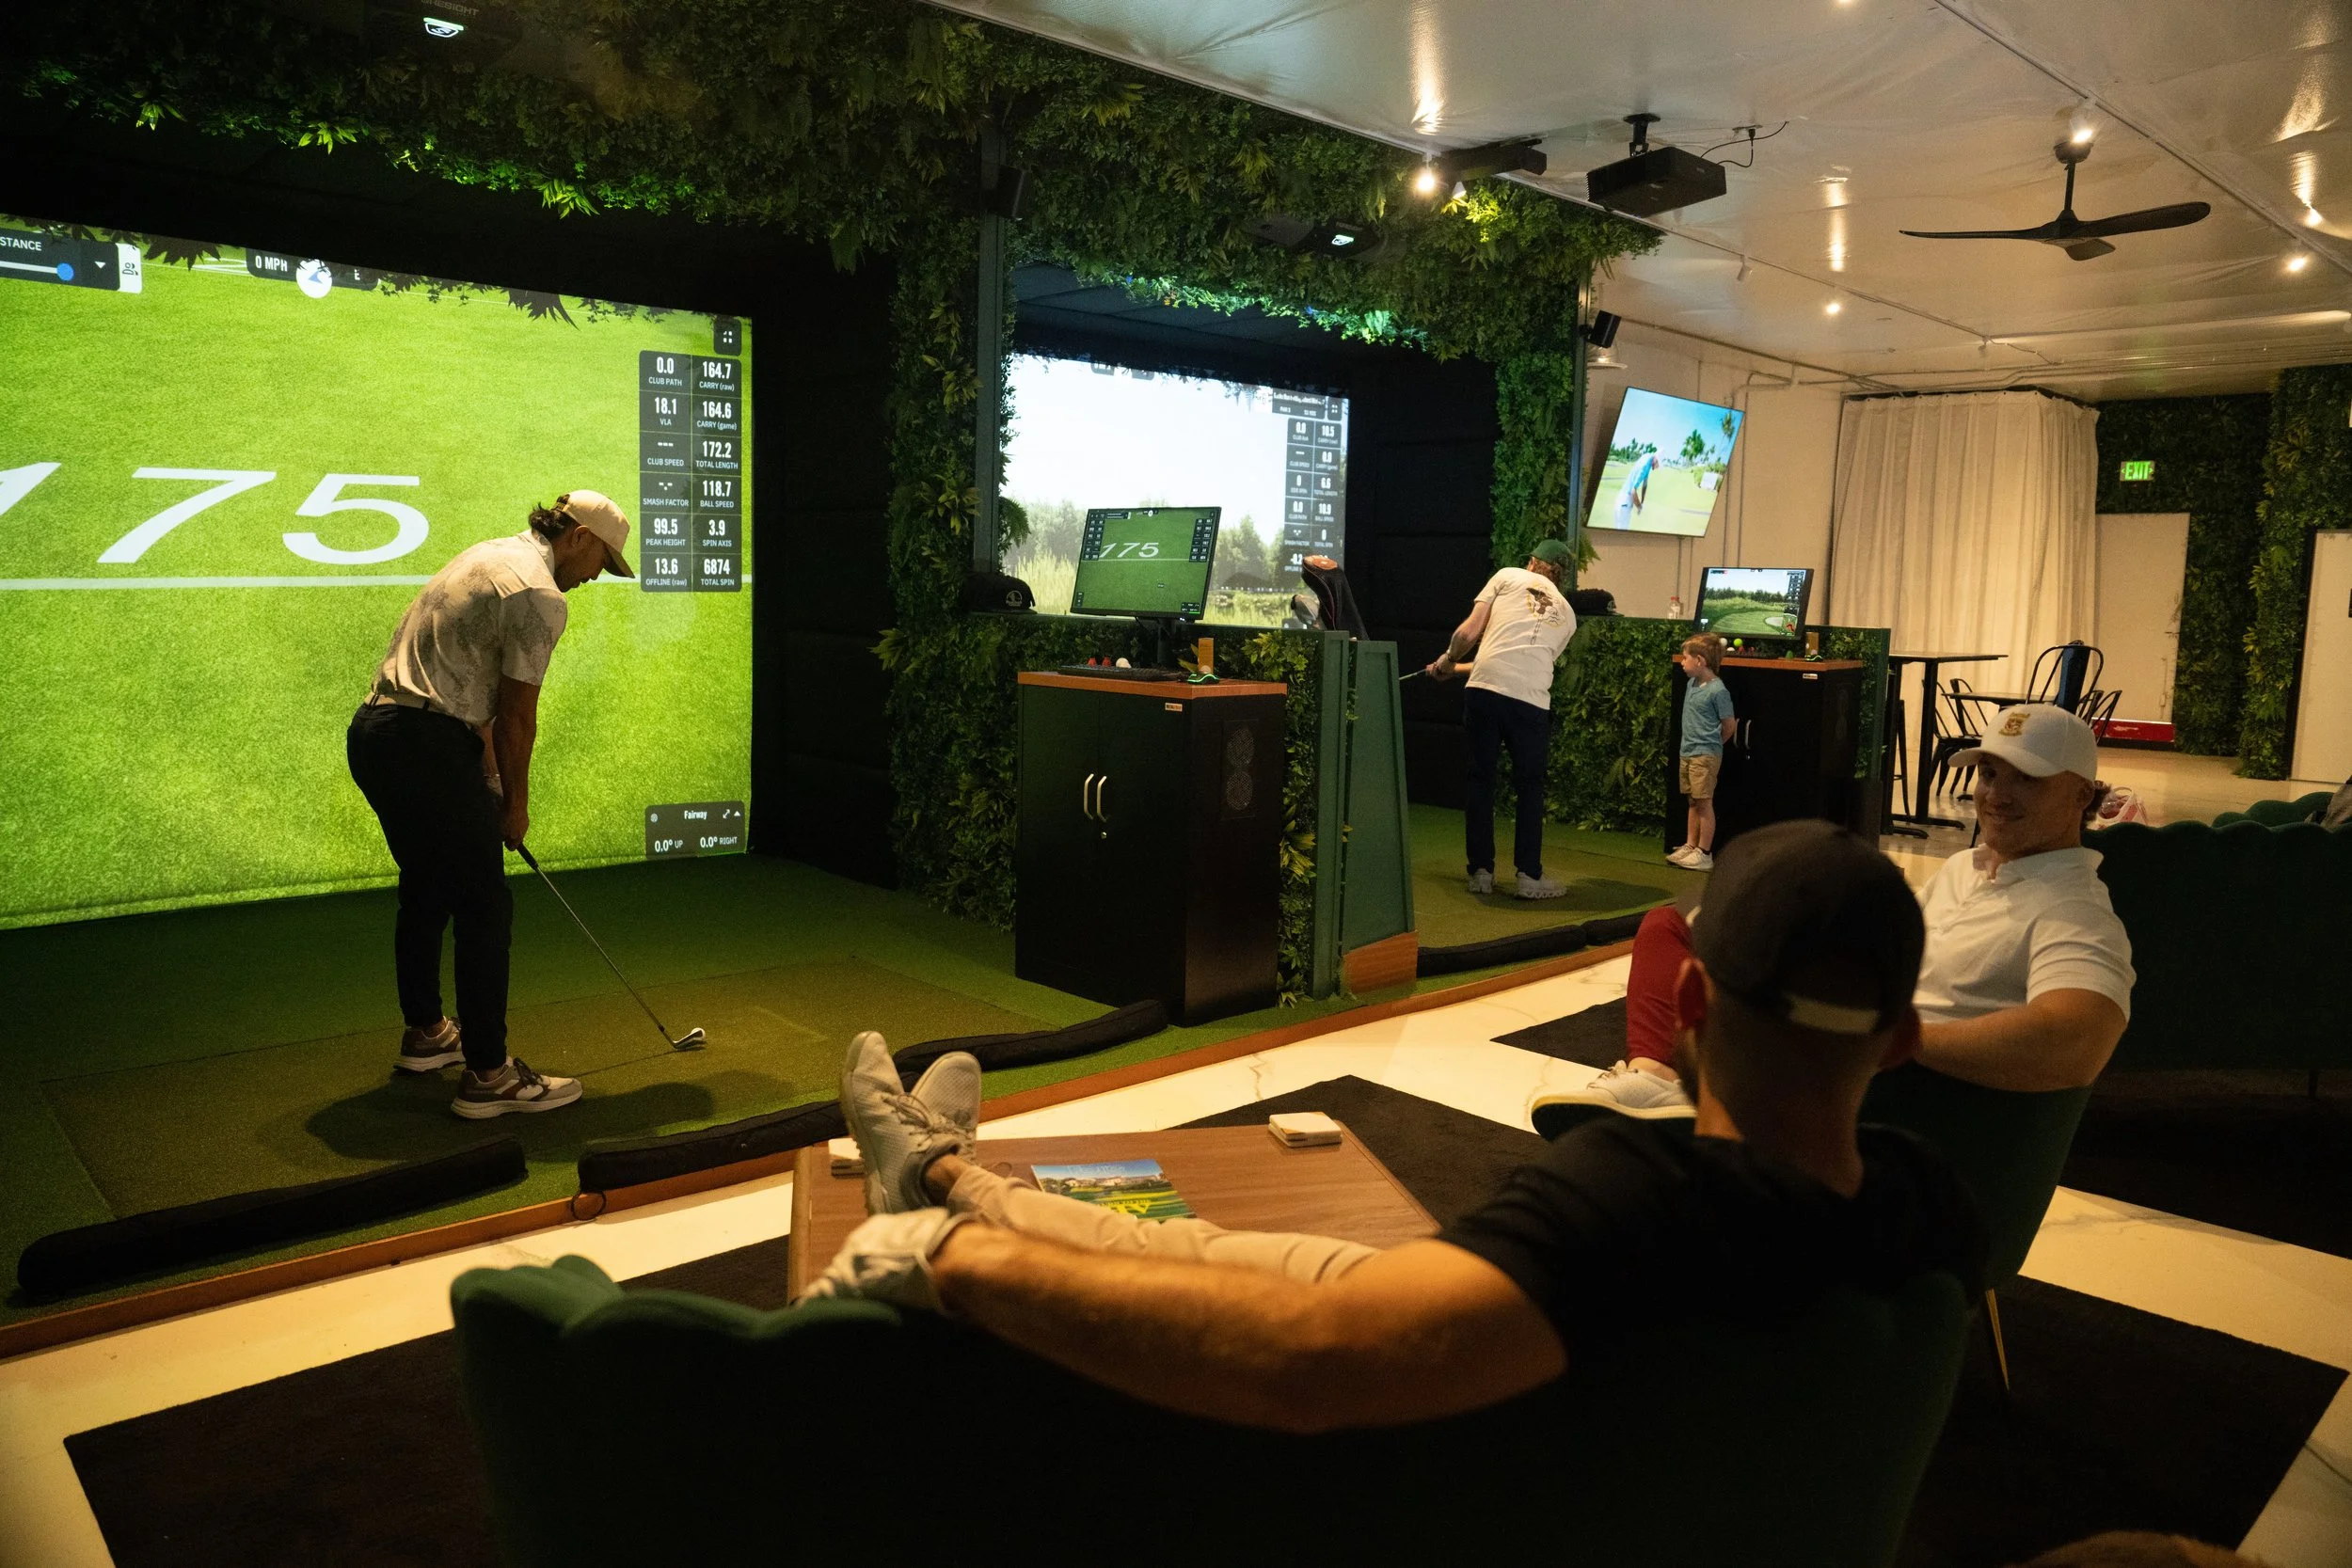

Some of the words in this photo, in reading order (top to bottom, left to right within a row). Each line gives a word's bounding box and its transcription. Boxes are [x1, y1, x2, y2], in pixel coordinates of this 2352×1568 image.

[0, 236, 42, 251] STANCE
[255, 255, 262, 269] 0
[264, 256, 288, 272] MPH
[657, 356, 675, 374] 0.0
[702, 360, 732, 379] 164.7
[648, 376, 664, 385] CLUB
[666, 377, 682, 387] PATH
[699, 381, 719, 389] CARRY
[720, 382, 735, 391] (raw)
[655, 397, 676, 415] 18.1
[702, 401, 732, 420] 164.6
[660, 418, 672, 426] VLA
[696, 420, 716, 429] CARRY
[717, 421, 738, 431] (game)
[702, 440, 732, 459] 172.2
[647, 457, 663, 466] CLUB
[664, 458, 685, 467] SPEED
[696, 460, 715, 468] TOTAL
[716, 461, 739, 469] LENGTH
[2124, 461, 2152, 481] EXIT
[703, 480, 732, 497] 118.7
[643, 498, 664, 506] SMASH
[665, 499, 690, 507] FACTOR
[700, 499, 714, 508] BALL
[715, 500, 734, 509] SPEED
[654, 517, 678, 535] 99.5
[708, 519, 725, 536] 3.9
[1099, 542, 1159, 558] 175
[654, 557, 678, 575] 13.6
[704, 558, 730, 575] 6874
[672, 578, 687, 587] (raw)
[684, 810, 707, 820] Fairway
[675, 839, 683, 848] UP
[719, 836, 738, 846] RIGHT
